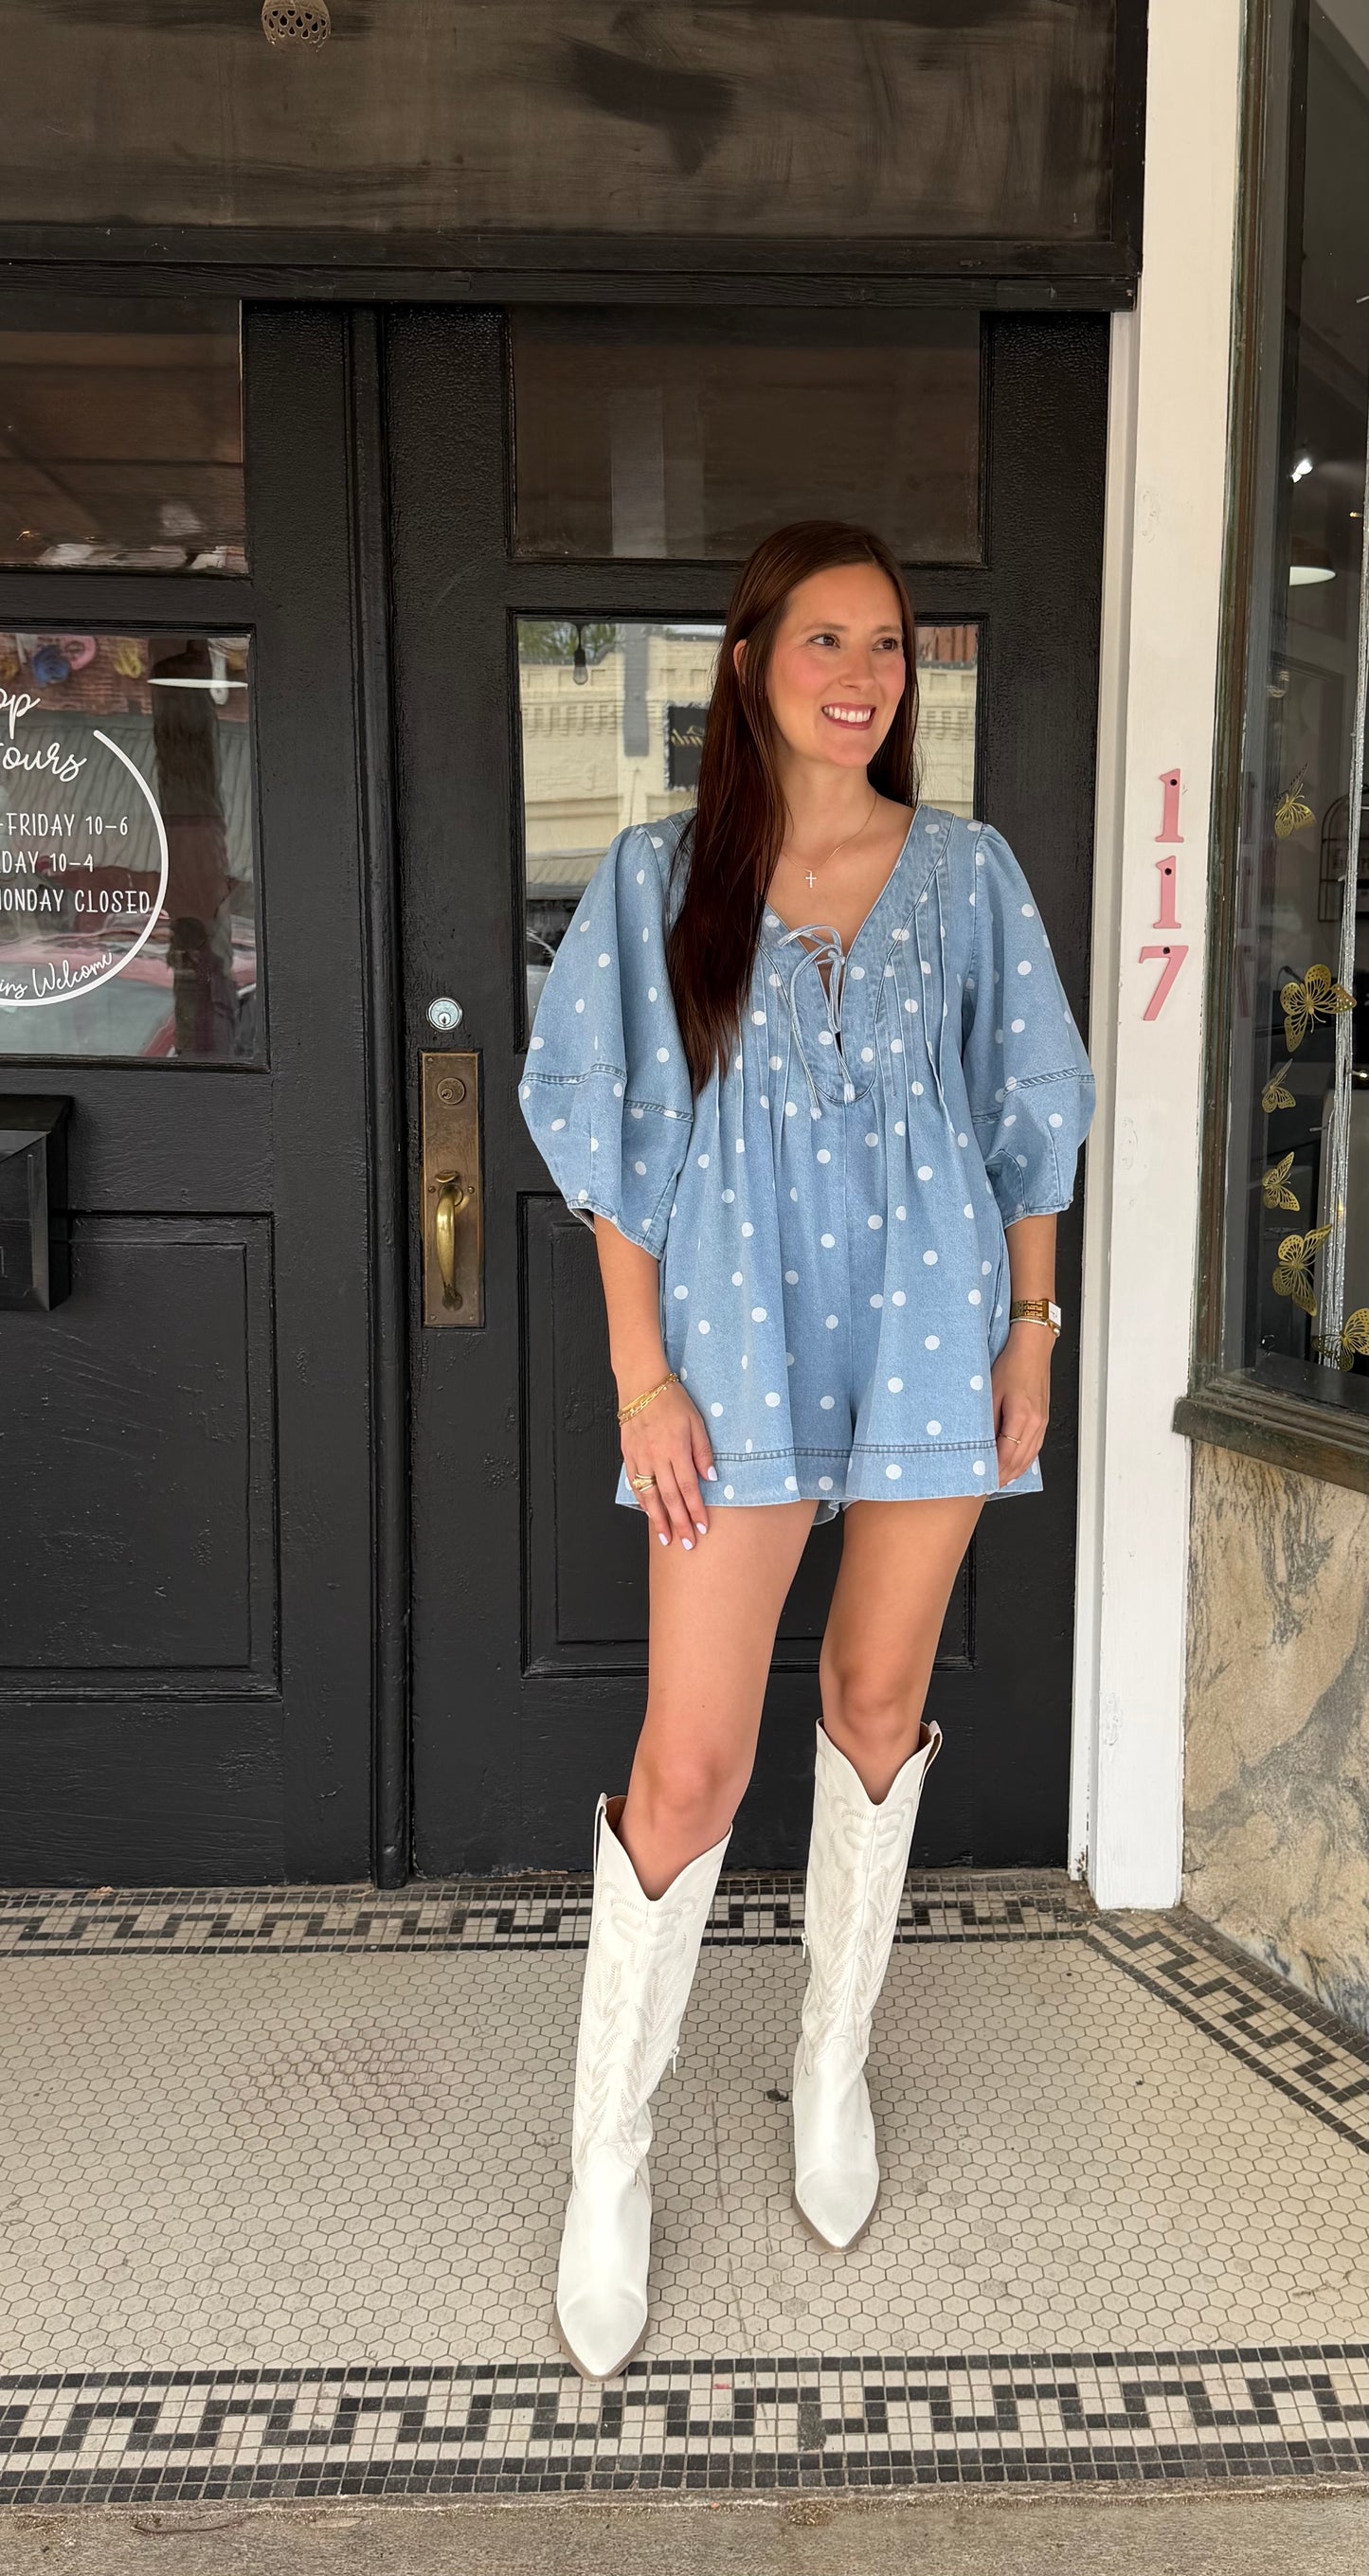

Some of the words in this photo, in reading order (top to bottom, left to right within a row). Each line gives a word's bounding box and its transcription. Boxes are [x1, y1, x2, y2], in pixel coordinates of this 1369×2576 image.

[0, 743, 87, 782] ours
[85, 816, 129, 836] 10-6
[0, 851, 39, 874] DAY
[49, 853, 94, 873] 10-4
[0, 888, 64, 911] ONDAY
[75, 889, 151, 914] CLOSED
[1139, 768, 1188, 1021] 117
[32, 952, 113, 998] Welcome
